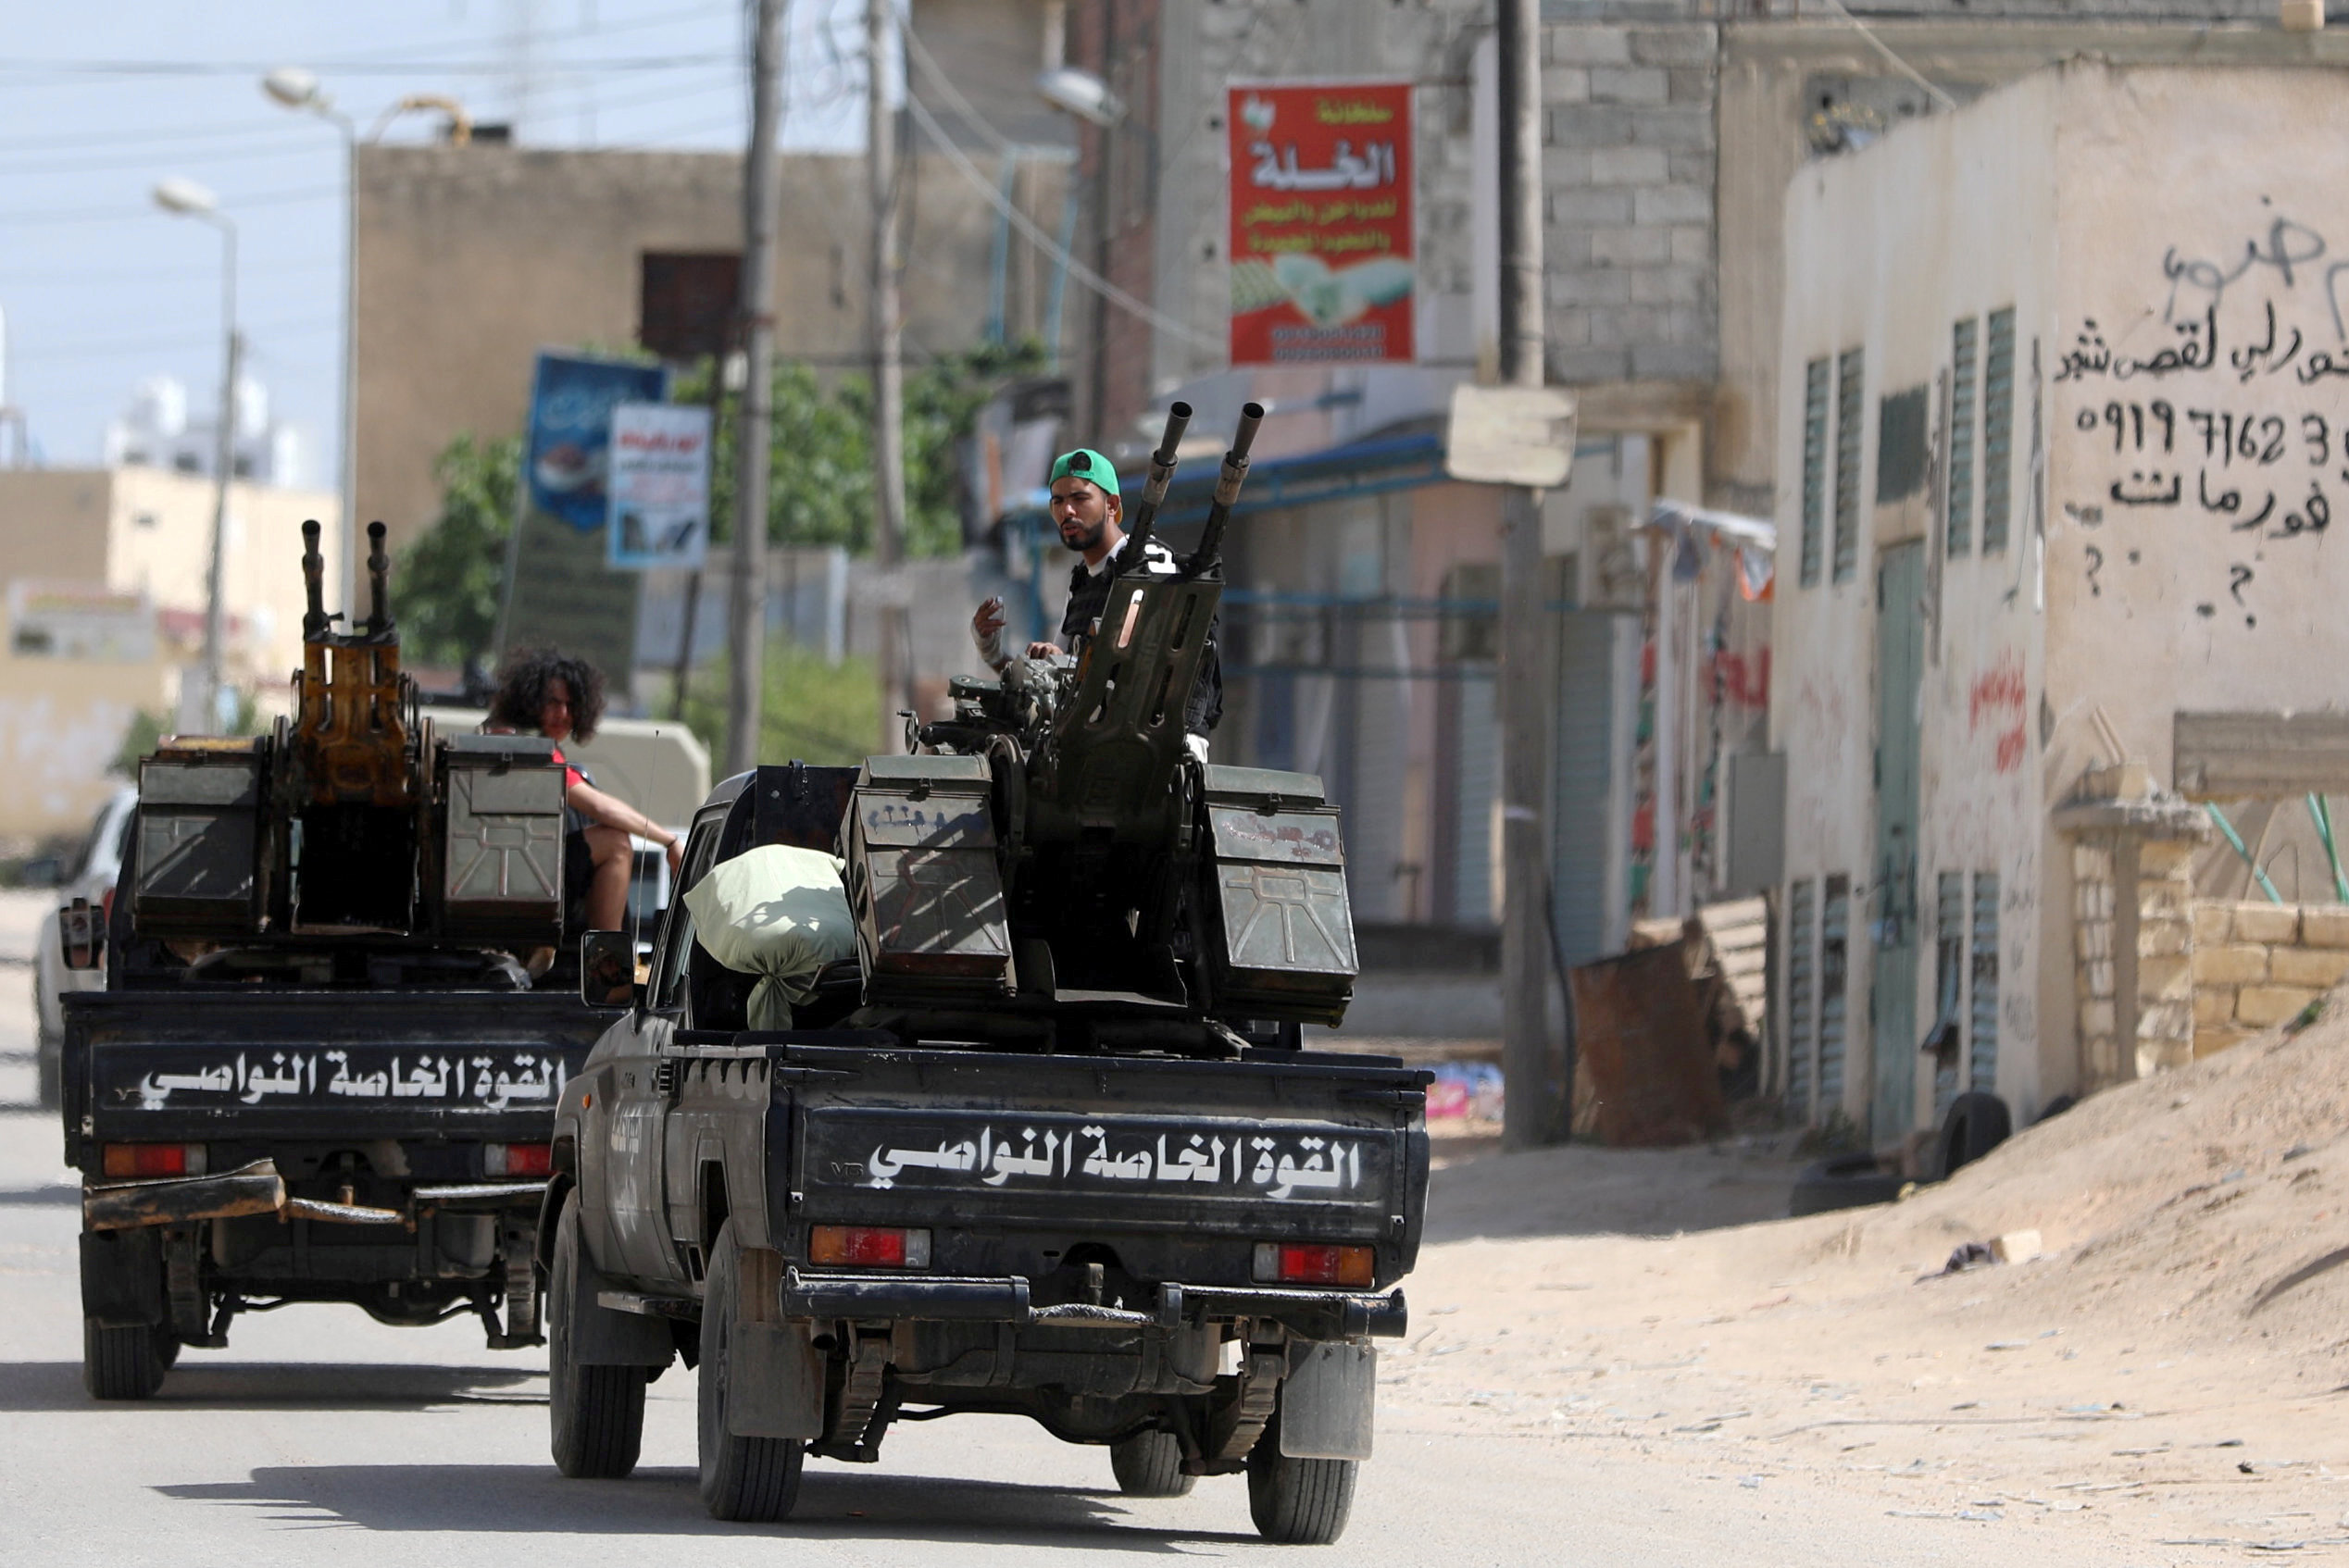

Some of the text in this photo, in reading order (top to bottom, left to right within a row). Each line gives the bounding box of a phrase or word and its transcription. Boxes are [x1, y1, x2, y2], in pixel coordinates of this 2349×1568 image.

[141, 1051, 568, 1111] القوة الخاصة النواصي
[868, 1124, 1360, 1199] القوة الخاصة النواصي
